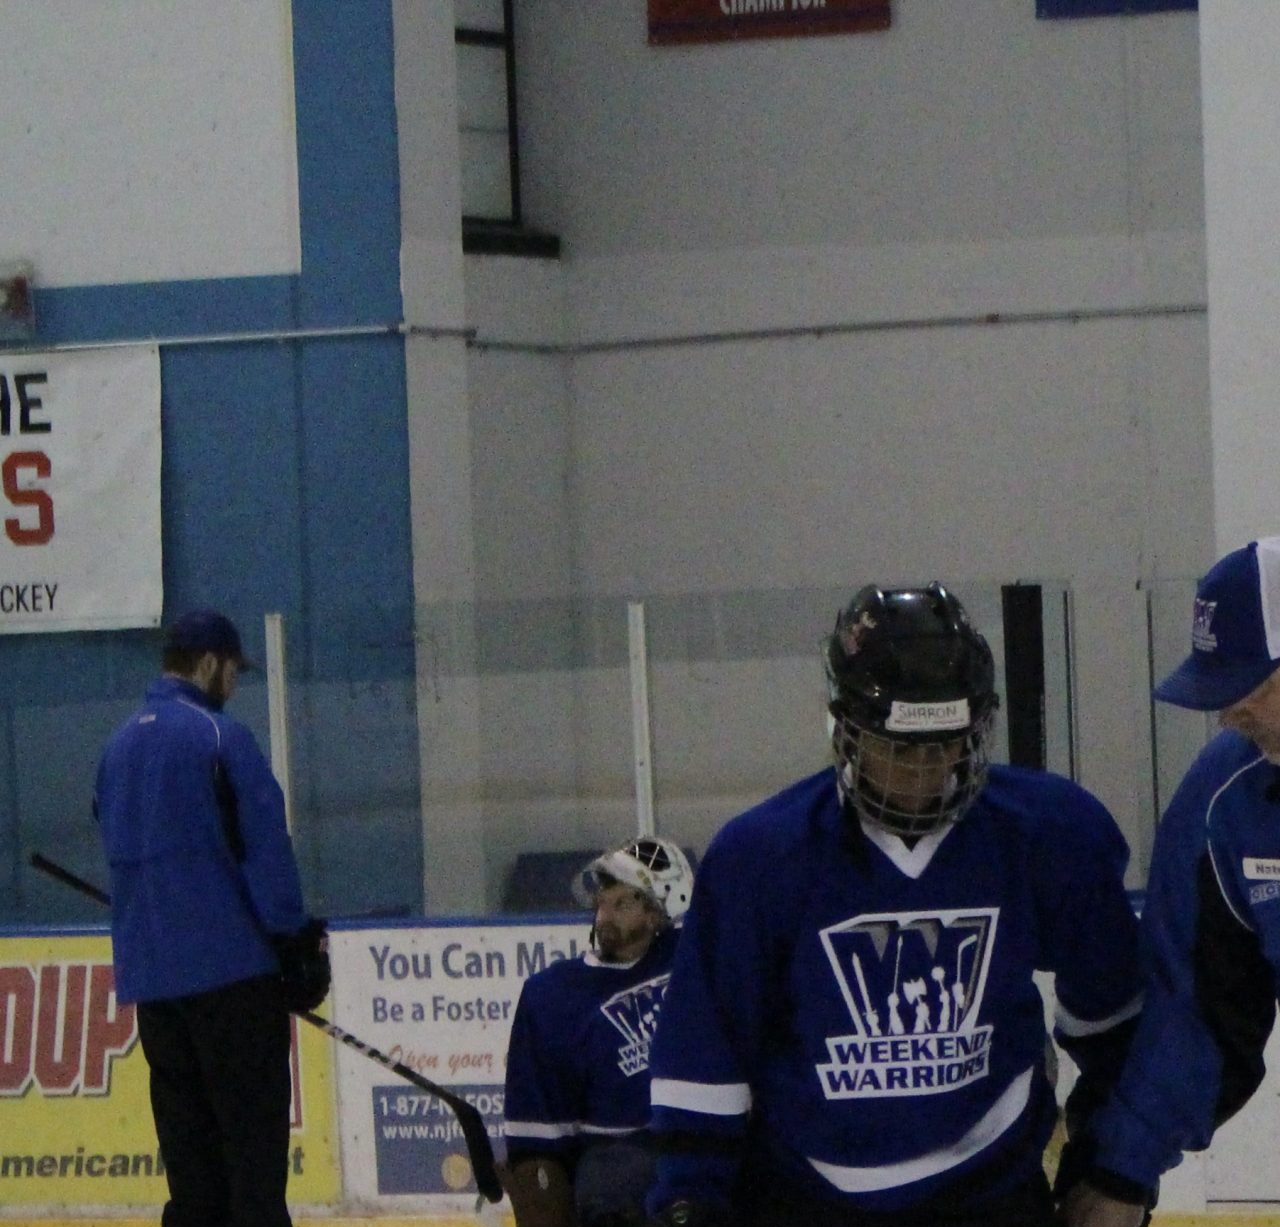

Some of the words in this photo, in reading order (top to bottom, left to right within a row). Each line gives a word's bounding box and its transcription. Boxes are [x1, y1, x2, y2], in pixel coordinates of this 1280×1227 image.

[1, 450, 55, 547] S
[899, 704, 957, 720] SHARON
[369, 945, 432, 980] You
[441, 943, 506, 979] Can
[372, 997, 408, 1022] Be
[411, 1003, 425, 1022] a
[433, 996, 511, 1022] Foster
[448, 1052, 494, 1076] your
[835, 1030, 988, 1066] WEEKEND
[825, 1055, 986, 1093] WARRIORS
